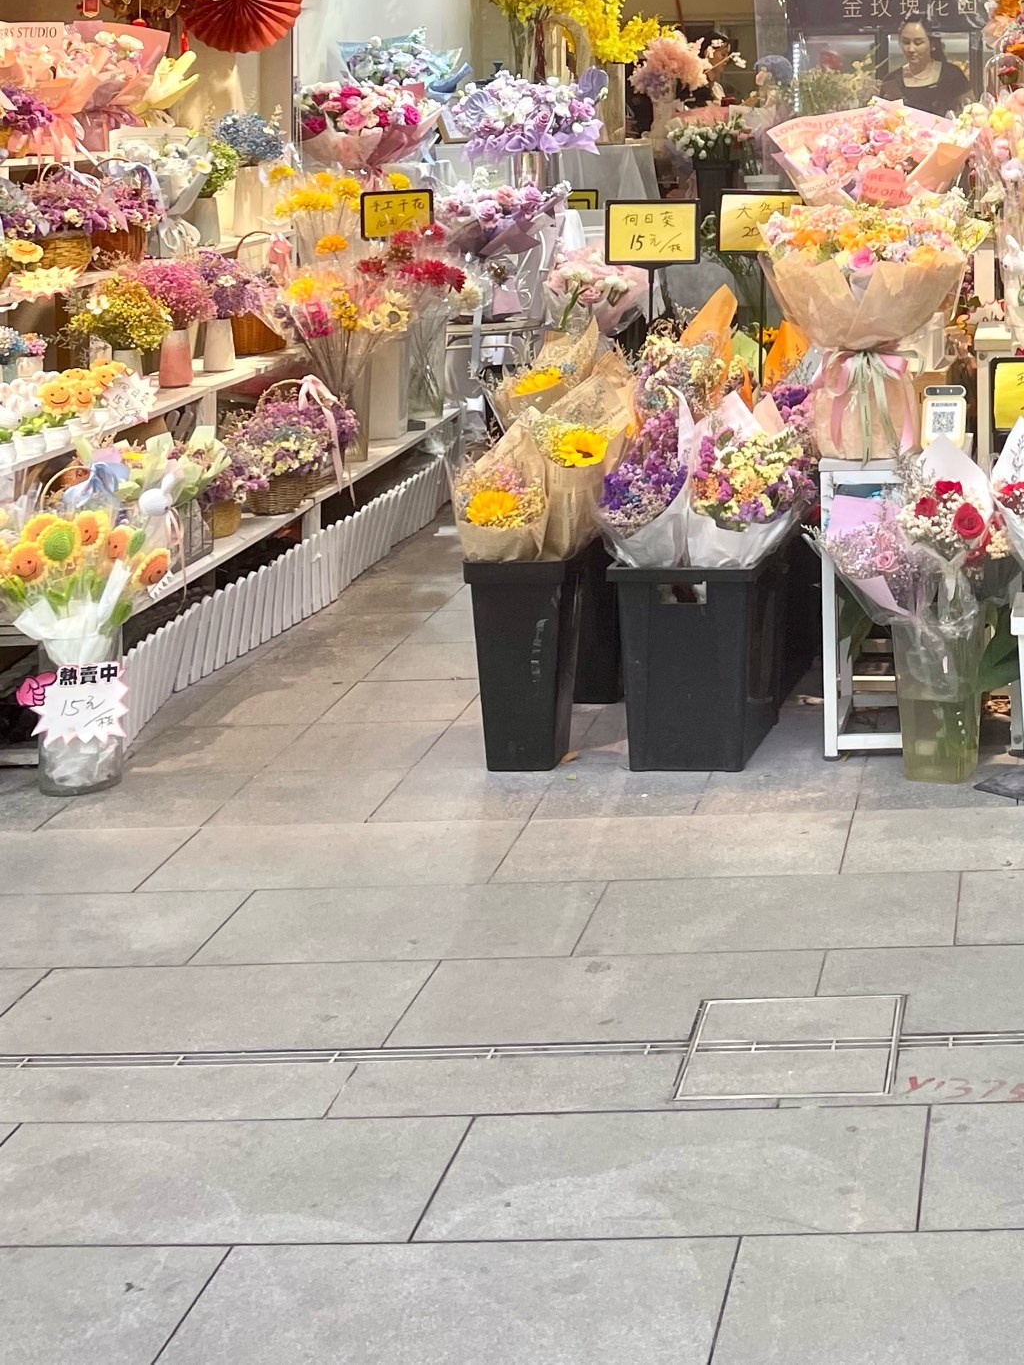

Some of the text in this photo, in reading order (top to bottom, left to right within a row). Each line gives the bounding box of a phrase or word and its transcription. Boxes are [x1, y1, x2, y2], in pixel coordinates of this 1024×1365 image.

[17, 26, 57, 38] STUDIO
[371, 198, 425, 213] 手工干花
[622, 211, 675, 228] 向日葵
[59, 664, 118, 686] 熱賣中
